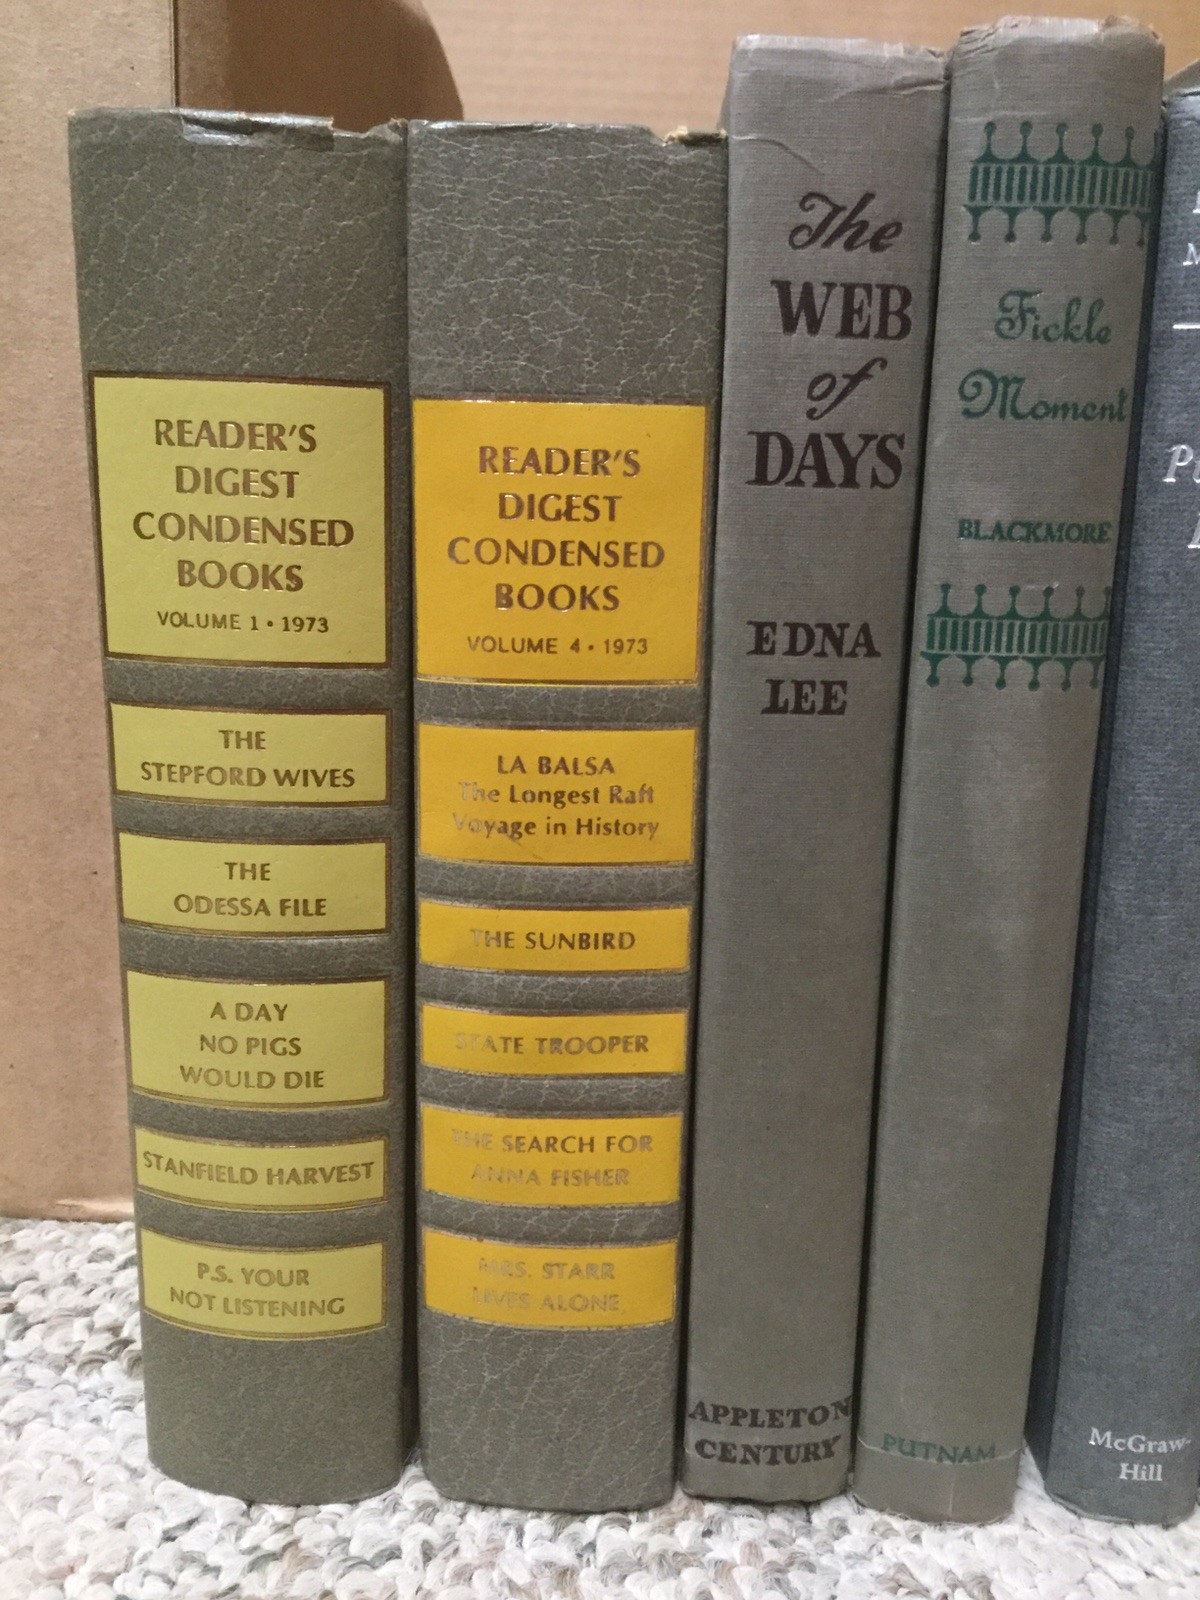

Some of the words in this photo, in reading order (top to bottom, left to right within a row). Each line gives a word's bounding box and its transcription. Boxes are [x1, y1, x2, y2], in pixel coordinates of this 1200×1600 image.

[788, 191, 903, 253] The
[770, 280, 913, 341] WEB
[994, 289, 1112, 345] Fickle
[805, 357, 888, 421] of
[957, 368, 1129, 422] Moment
[155, 419, 317, 453] READER'S
[479, 446, 641, 478] READER'S
[745, 431, 906, 489] DAYS
[175, 465, 300, 499] DIGEST
[498, 493, 622, 522] DIGEST
[132, 511, 355, 547] CONDENSED
[956, 518, 1113, 544] BLACKMORE
[447, 537, 665, 568] CONDENSED
[177, 560, 304, 592] BOOKS
[495, 583, 620, 612] BOOKS
[157, 611, 240, 630] VOLUME
[282, 617, 329, 633] 1973
[467, 635, 558, 654] VOLUME
[603, 638, 648, 655] 1973
[746, 620, 882, 658] EDNA
[760, 678, 848, 716] LEE
[218, 729, 266, 750] THE
[141, 761, 266, 787] STEPFORD
[273, 768, 355, 788] WIVES
[497, 755, 526, 775] LA
[538, 756, 615, 776] BALSA
[458, 781, 500, 802] The
[509, 785, 600, 809] Longest
[609, 784, 655, 805] Raft
[452, 813, 537, 840] Voyage
[546, 816, 567, 835] in
[576, 818, 660, 841] History
[224, 862, 271, 881] THE
[174, 894, 270, 917] ODESSA
[279, 898, 327, 916] FILE
[470, 929, 515, 949] THE
[525, 931, 636, 950] SUNBIRD
[210, 1001, 227, 1020] A
[234, 1002, 288, 1022] DAY
[200, 1035, 238, 1055] NO
[245, 1037, 302, 1057] PIGS
[455, 1032, 525, 1054] STATE
[535, 1035, 649, 1055] TROOPER
[180, 1065, 276, 1089] WOULD
[284, 1070, 325, 1089] DIE
[451, 1128, 493, 1149] THE
[502, 1135, 595, 1154] SEARCH
[606, 1135, 654, 1153] FOR
[143, 1151, 258, 1185] STANFIELD
[266, 1161, 375, 1185] HARVEST
[471, 1164, 541, 1186] ANNA
[551, 1168, 630, 1187] FISHER
[197, 1262, 233, 1283] P.S.
[240, 1267, 310, 1286] YOUR
[542, 1262, 616, 1280] STARR
[169, 1286, 216, 1311] NOT
[222, 1297, 345, 1317] LISTENING
[472, 1287, 532, 1309] LIVES
[540, 1294, 620, 1312] ALONE
[687, 1396, 852, 1429] APPLETON
[694, 1434, 842, 1466] CENTURY
[881, 1433, 996, 1464] PUTNAM
[1119, 1463, 1163, 1482] Hill
